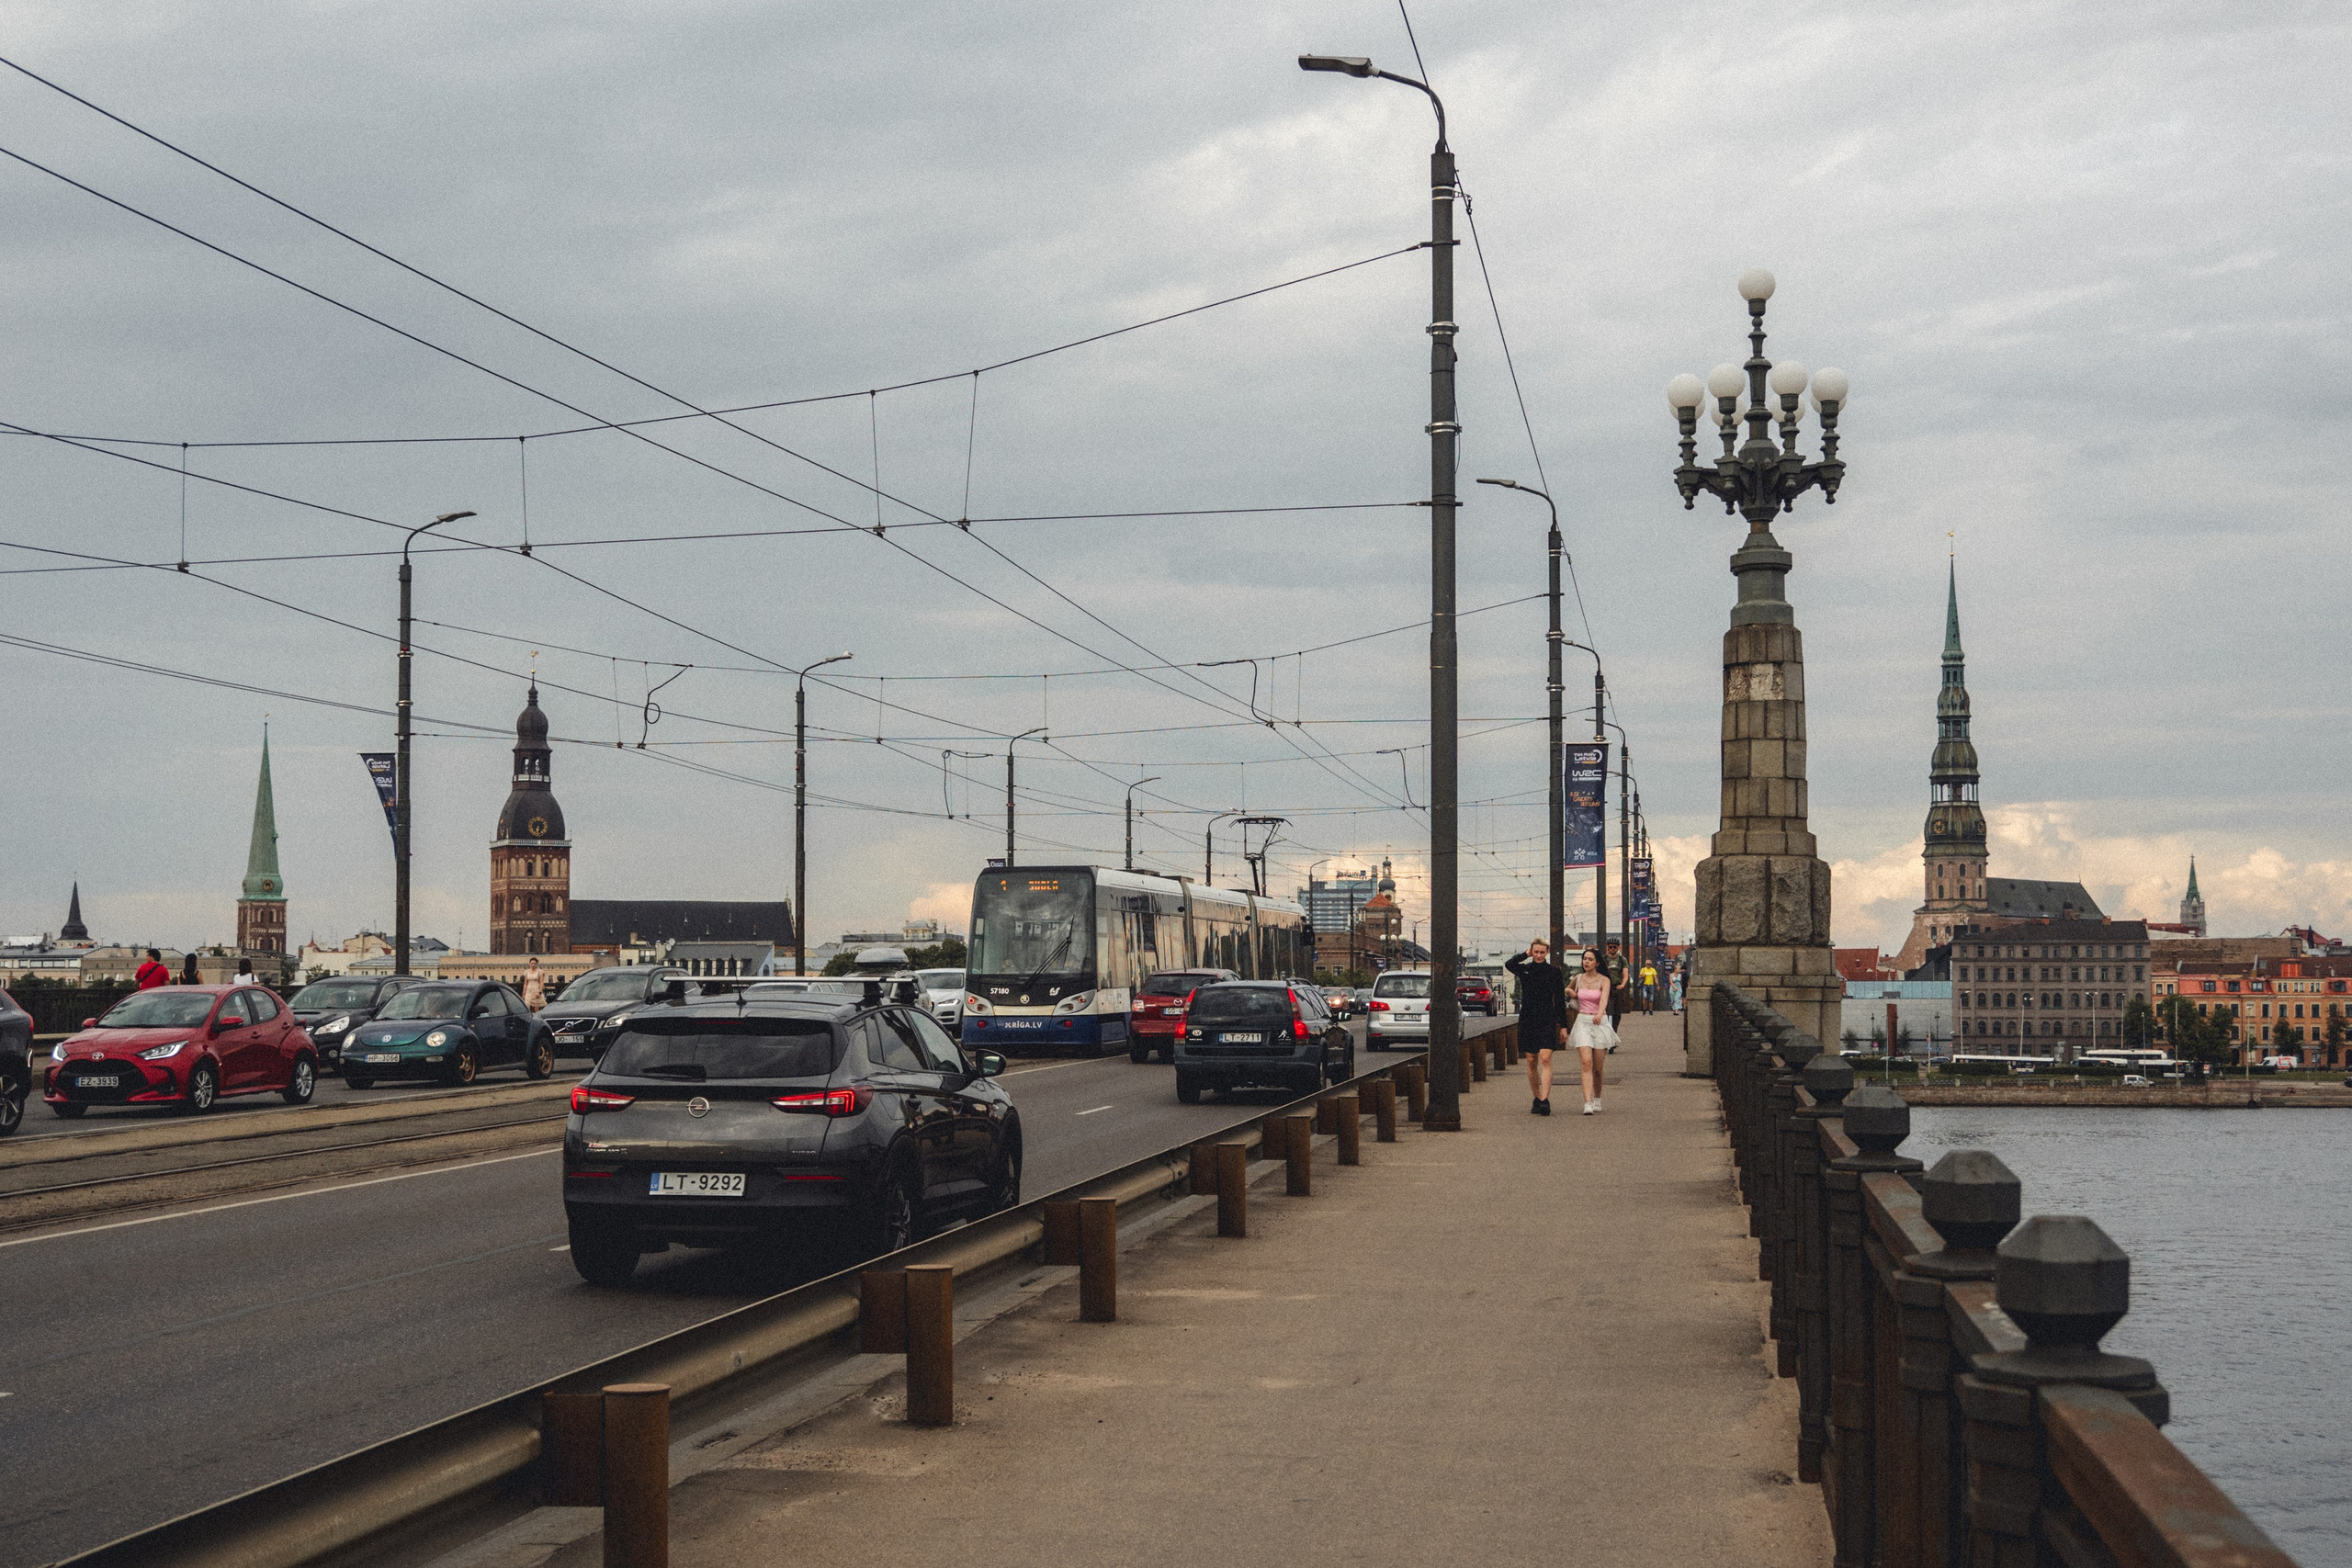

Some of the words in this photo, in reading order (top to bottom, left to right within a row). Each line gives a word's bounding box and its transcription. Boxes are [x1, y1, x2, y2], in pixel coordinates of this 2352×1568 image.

[1572, 769, 1602, 777] WRC
[1000, 879, 1007, 891] 1
[1012, 1020, 1043, 1029] RĪGA.LV
[1224, 1033, 1261, 1042] LT-2711
[80, 1077, 118, 1086] EZ-3939
[662, 1174, 742, 1190] LT-9292
